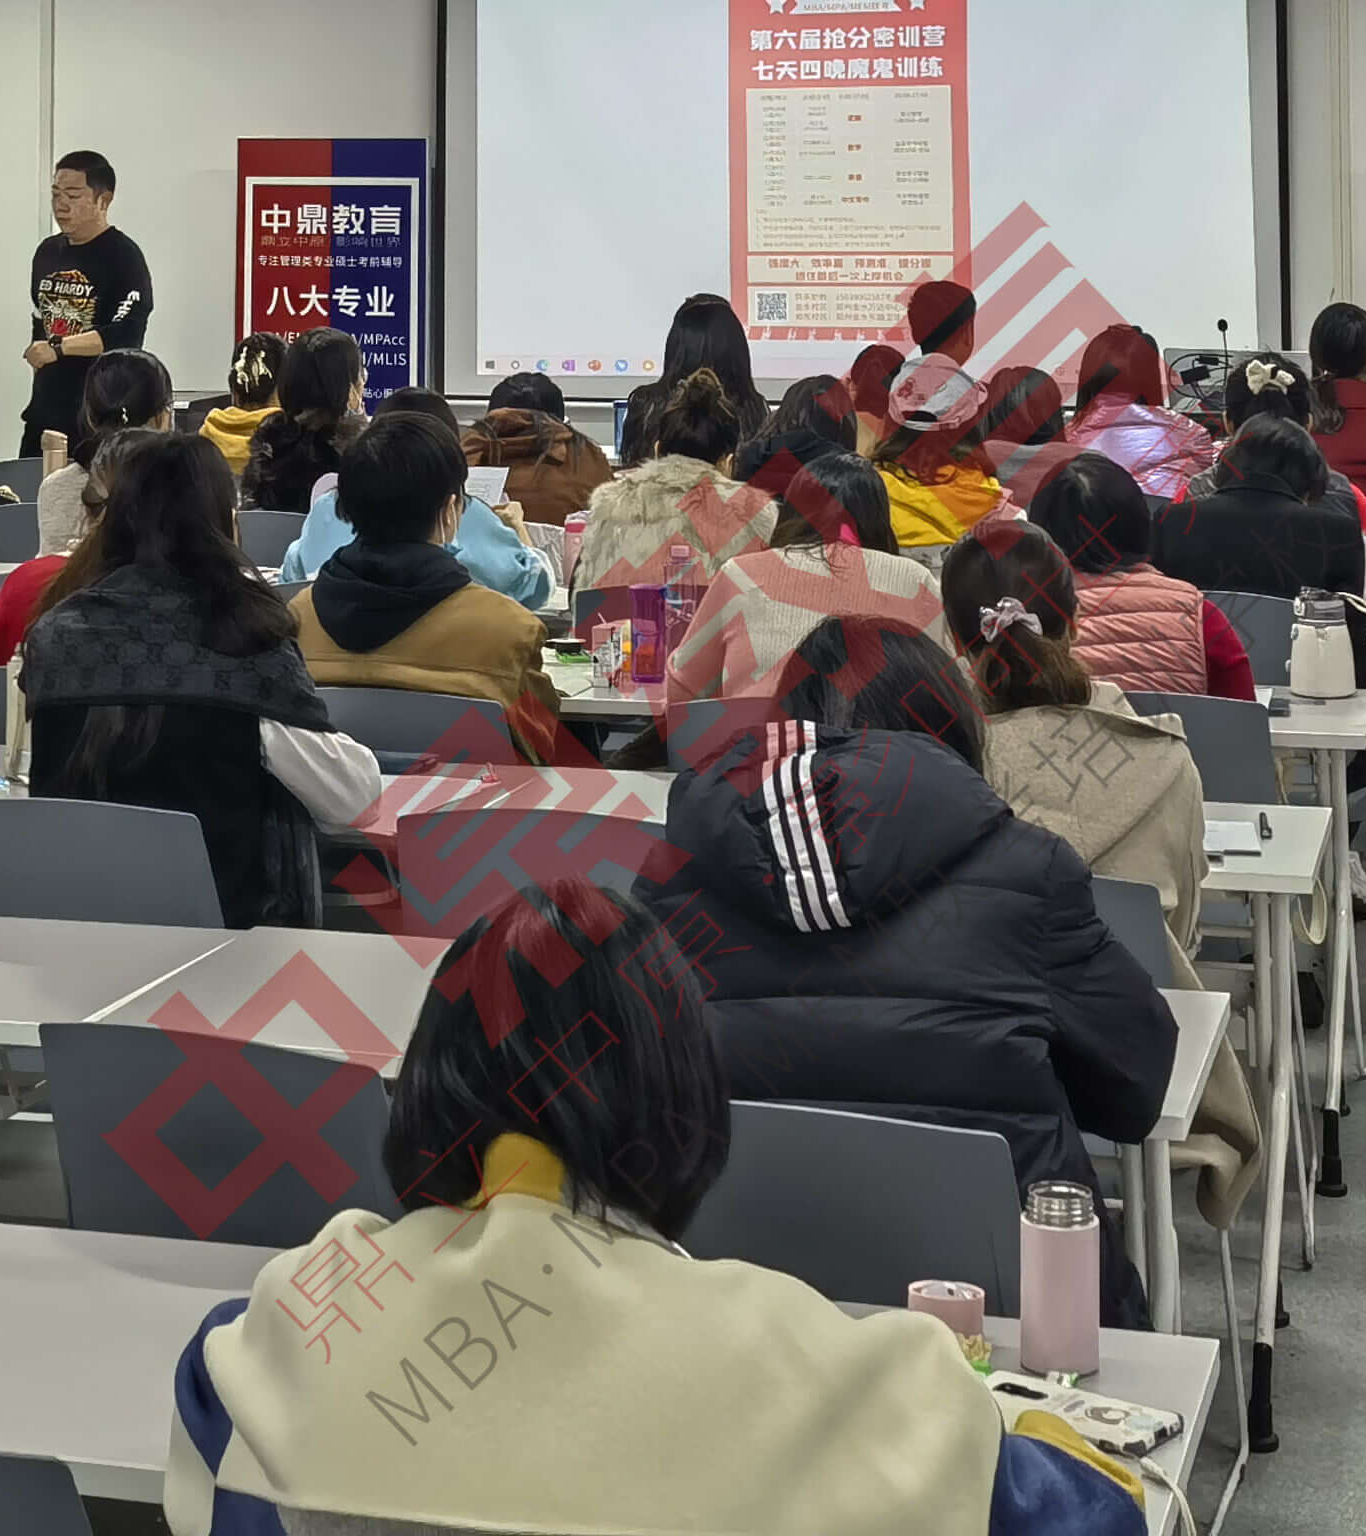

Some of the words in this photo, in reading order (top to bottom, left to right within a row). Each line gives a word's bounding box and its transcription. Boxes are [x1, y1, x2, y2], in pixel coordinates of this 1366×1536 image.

[750, 26, 945, 52] 第六届抢分密训营
[751, 56, 943, 81] 七天四晚魔鬼训练
[261, 204, 402, 235] 中鼎教育
[54, 281, 94, 297] HARDY
[266, 285, 396, 318] 八大专业
